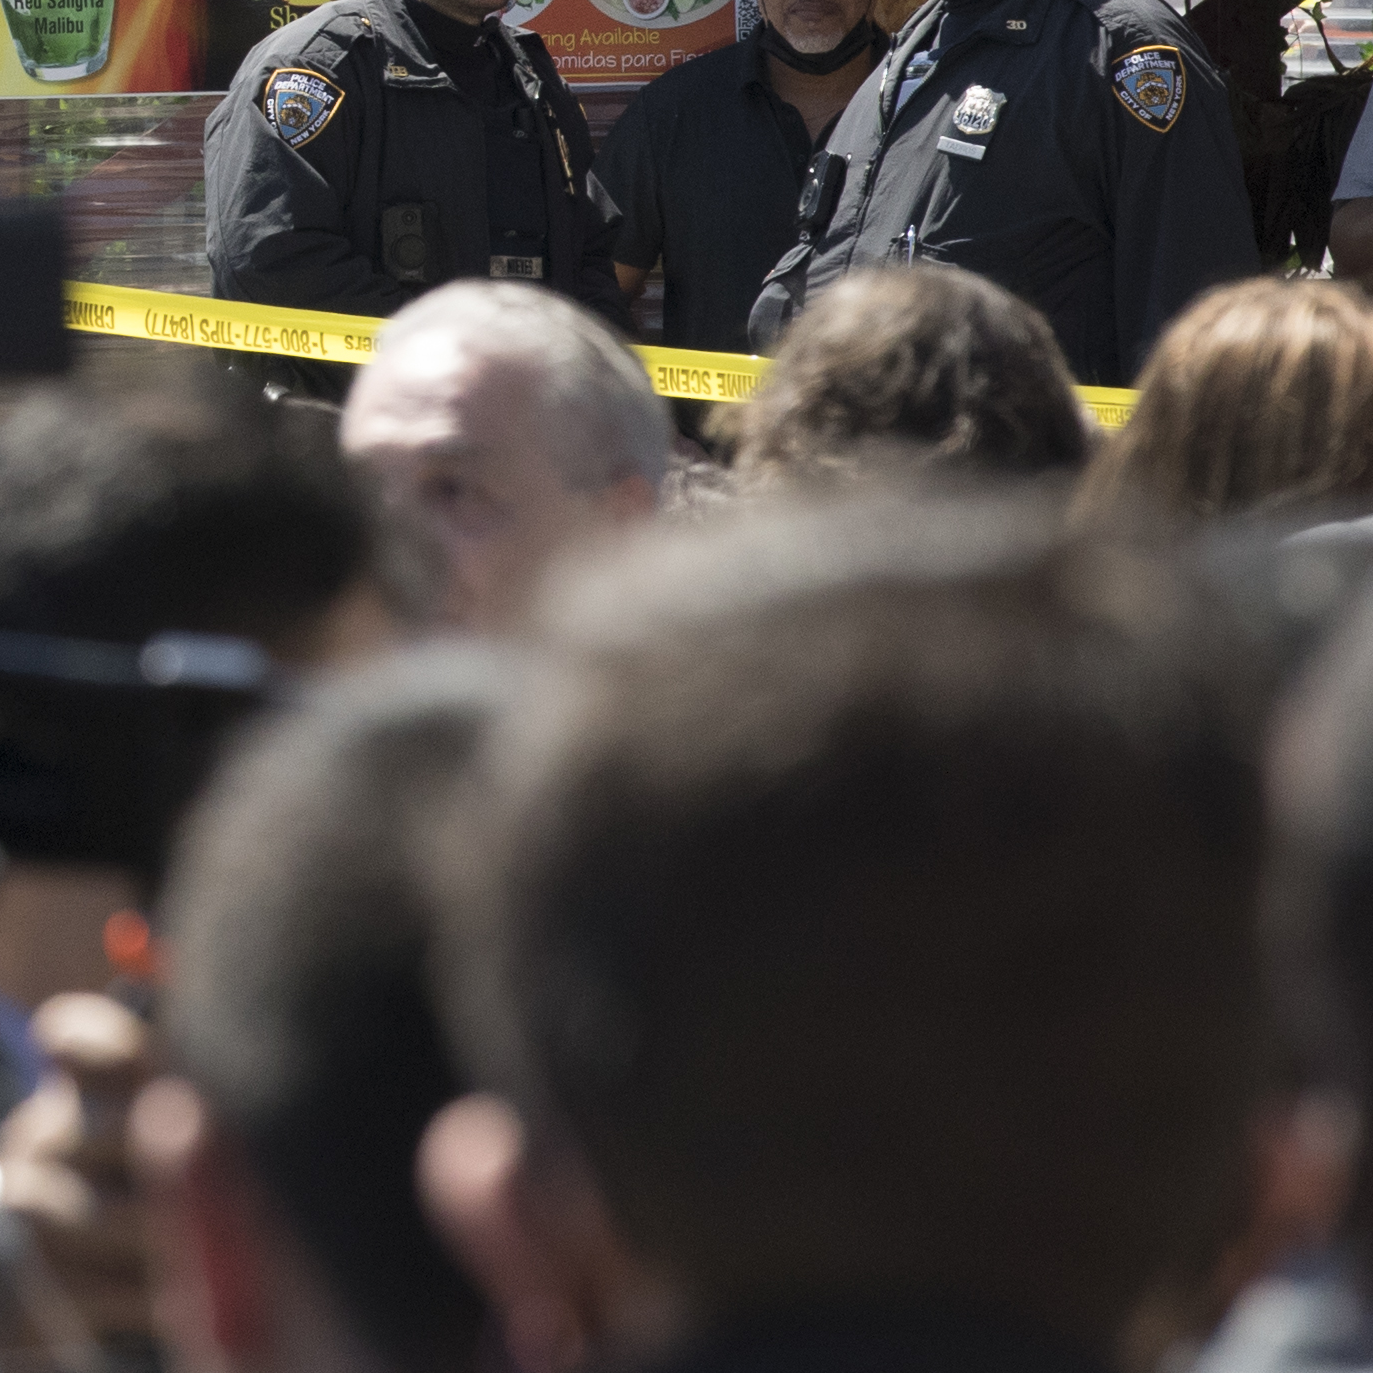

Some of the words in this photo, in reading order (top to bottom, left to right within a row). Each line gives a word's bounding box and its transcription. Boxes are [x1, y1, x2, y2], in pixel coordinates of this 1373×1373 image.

[33, 17, 85, 35] Malibu
[579, 27, 661, 47] Available
[1006, 19, 1028, 31] 30
[552, 51, 617, 69] omidas
[621, 55, 667, 72] para
[1123, 51, 1161, 67] POLICE
[289, 73, 327, 92] POLICE
[1114, 60, 1178, 83] DEPARTMENT
[273, 80, 335, 105] DEPARTMENT
[1165, 102, 1179, 122] NEW
[1173, 74, 1183, 102] YORK
[266, 98, 275, 120] CITY
[1119, 90, 1139, 111] CITY
[1137, 107, 1153, 121] OF
[289, 129, 310, 146] NEW
[308, 109, 331, 133] YORK
[144, 308, 195, 343] (8477)
[199, 318, 329, 357] 1-800-577-TIPS
[658, 366, 712, 396] SCENE
[717, 372, 761, 399] RIME
